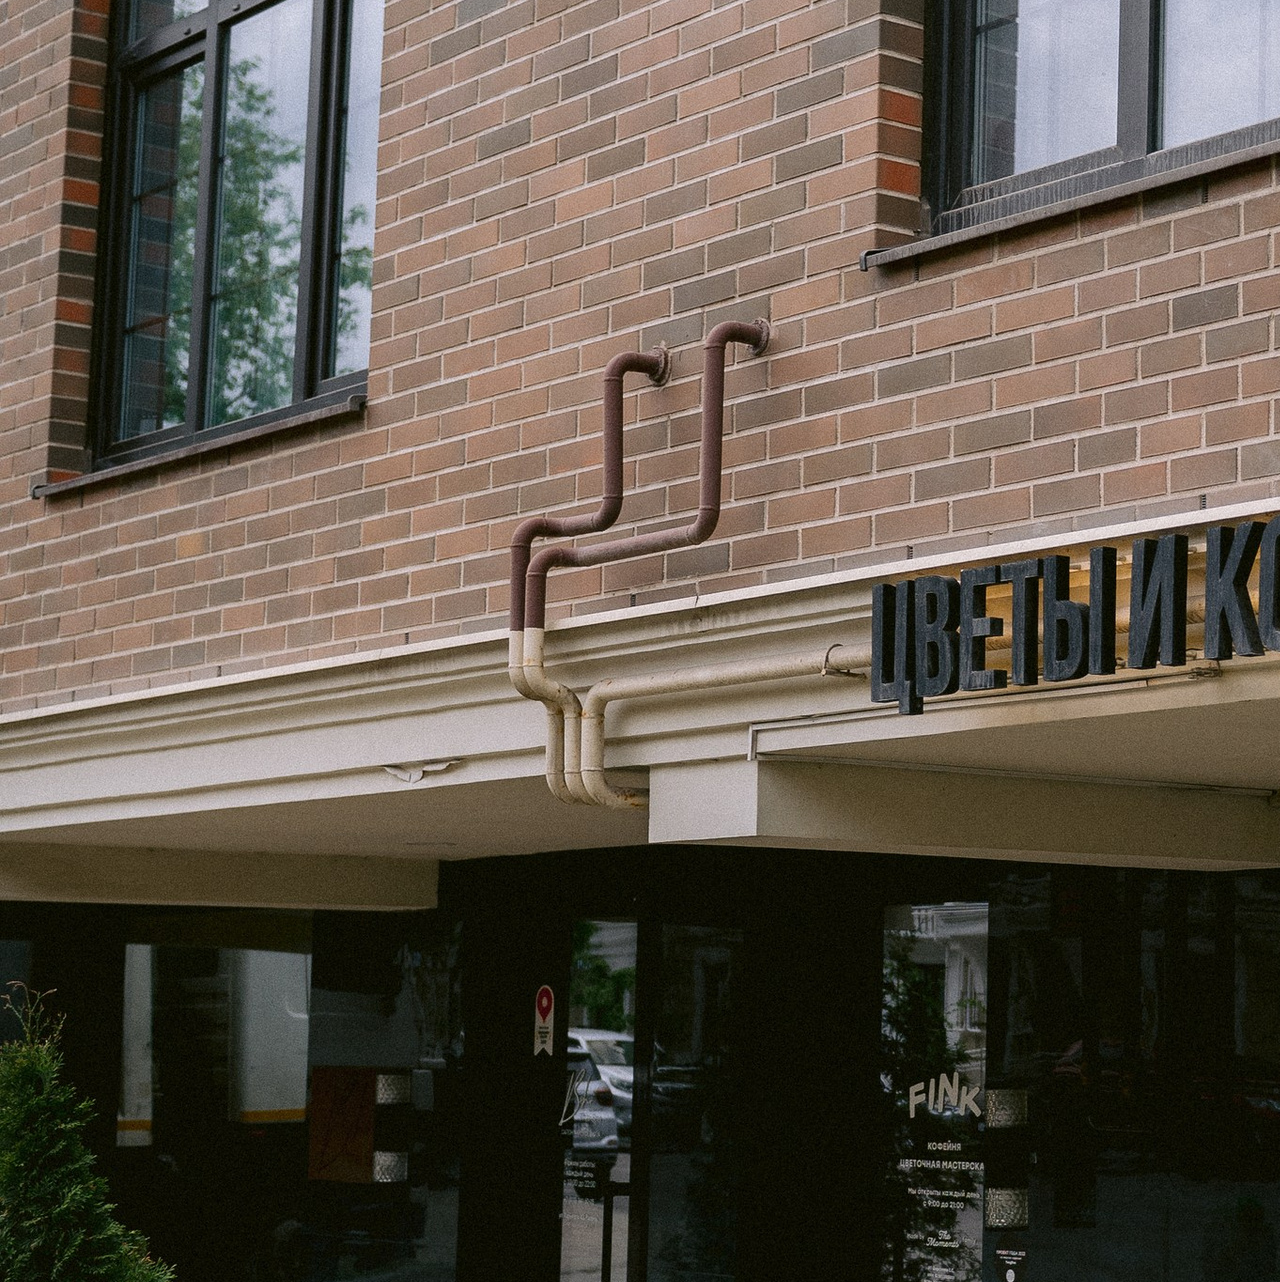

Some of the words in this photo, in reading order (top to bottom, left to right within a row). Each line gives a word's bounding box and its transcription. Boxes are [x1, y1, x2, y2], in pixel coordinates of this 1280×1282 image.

[870, 546, 1117, 715] ЦВЕТЫ
[1128, 533, 1189, 670] И
[909, 1071, 982, 1119] FINK
[927, 1140, 962, 1151] КОФЕЙНЯ
[899, 1158, 941, 1169] ЦВЕТОЧНАЯ
[942, 1160, 985, 1170] МАСТЕРСКА
